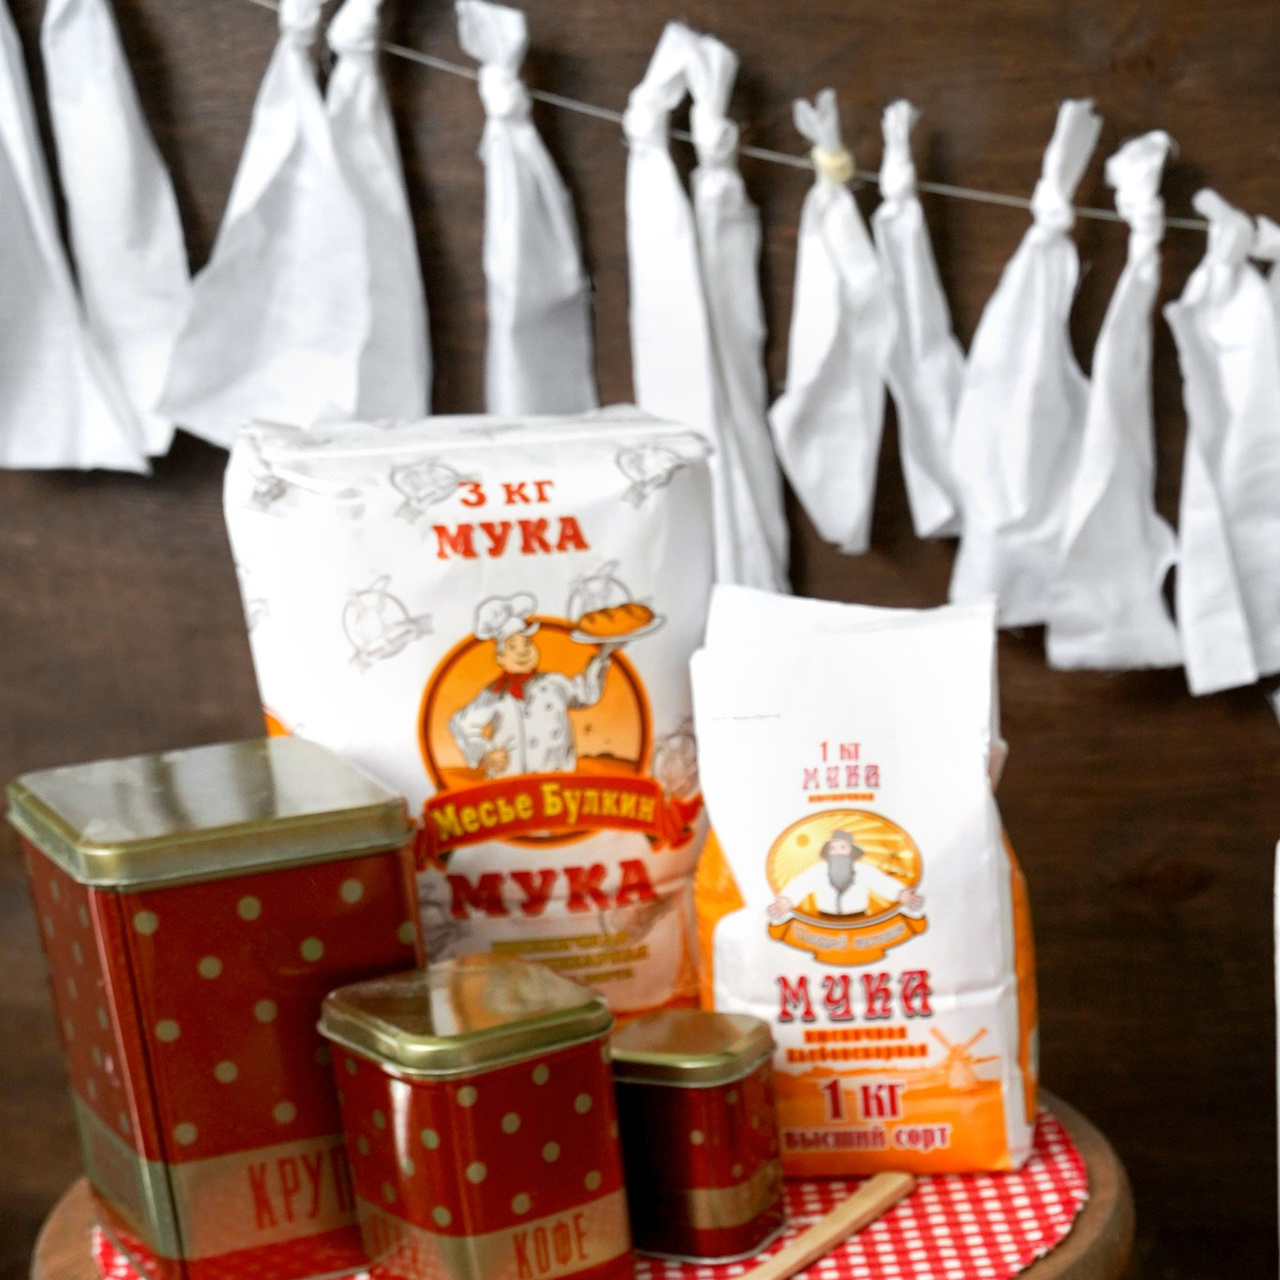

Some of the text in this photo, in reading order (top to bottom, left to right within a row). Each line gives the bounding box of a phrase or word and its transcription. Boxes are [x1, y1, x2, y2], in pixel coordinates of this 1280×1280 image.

[457, 480, 487, 508] 3
[432, 515, 590, 559] МУКА
[821, 740, 828, 762] 1
[432, 782, 655, 841] Месье Булкин
[447, 859, 659, 920] МУКА
[777, 969, 934, 1023] МУКА
[823, 1079, 842, 1119] 1
[895, 1126, 948, 1151] сорт
[247, 1146, 356, 1231] КРУП
[512, 1212, 589, 1280] КОФЕ
